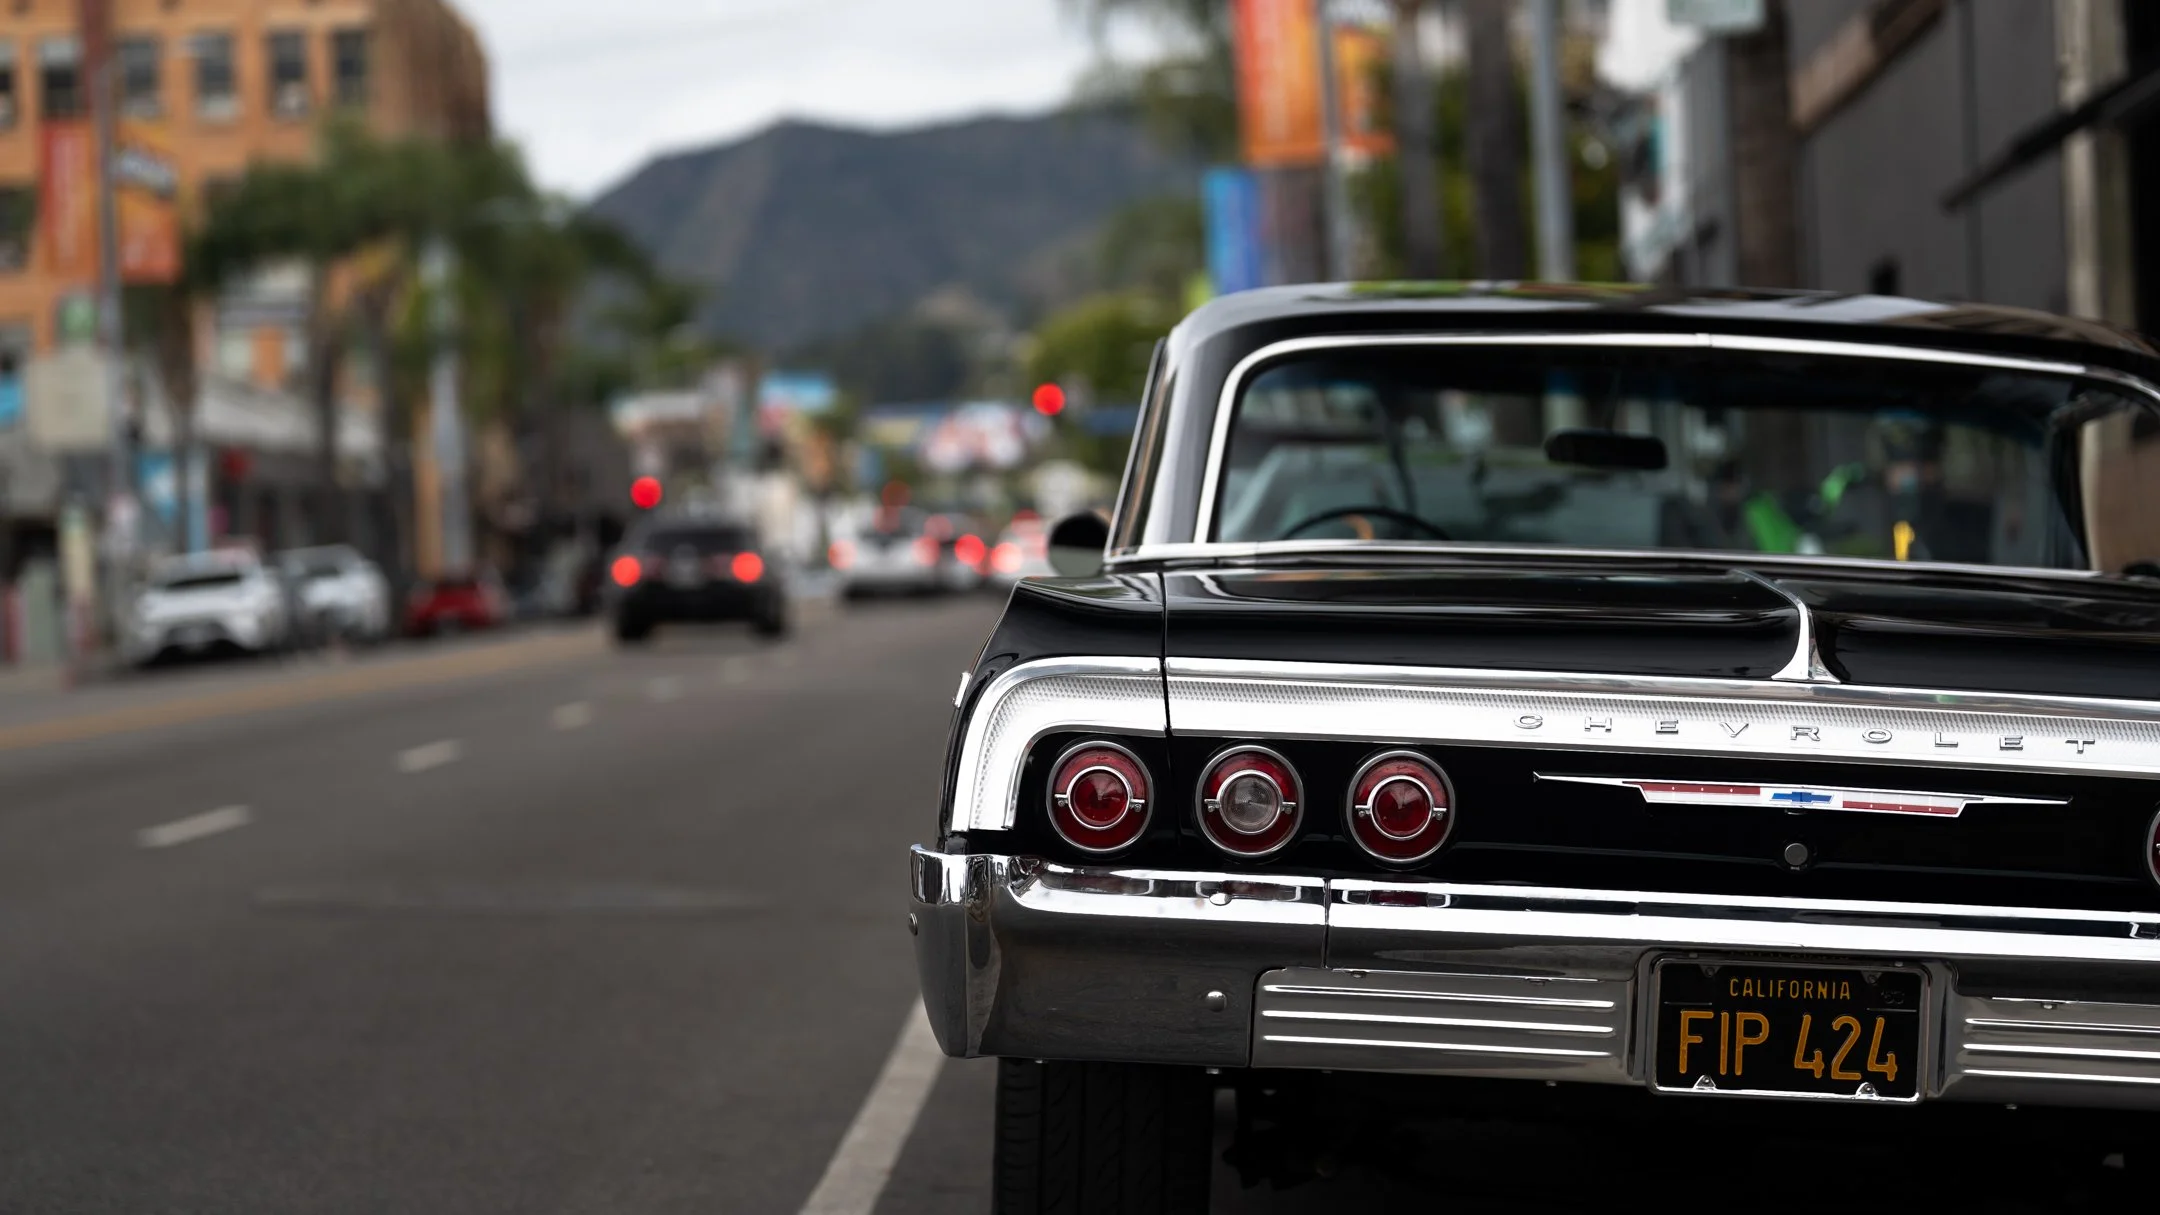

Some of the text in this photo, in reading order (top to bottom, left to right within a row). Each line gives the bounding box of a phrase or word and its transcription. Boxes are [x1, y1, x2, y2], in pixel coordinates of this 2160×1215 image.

[1514, 714, 2095, 754] CHEVROLET
[1729, 978, 1850, 1000] CALIFORNIA
[1679, 1010, 1898, 1082] FIP 424
